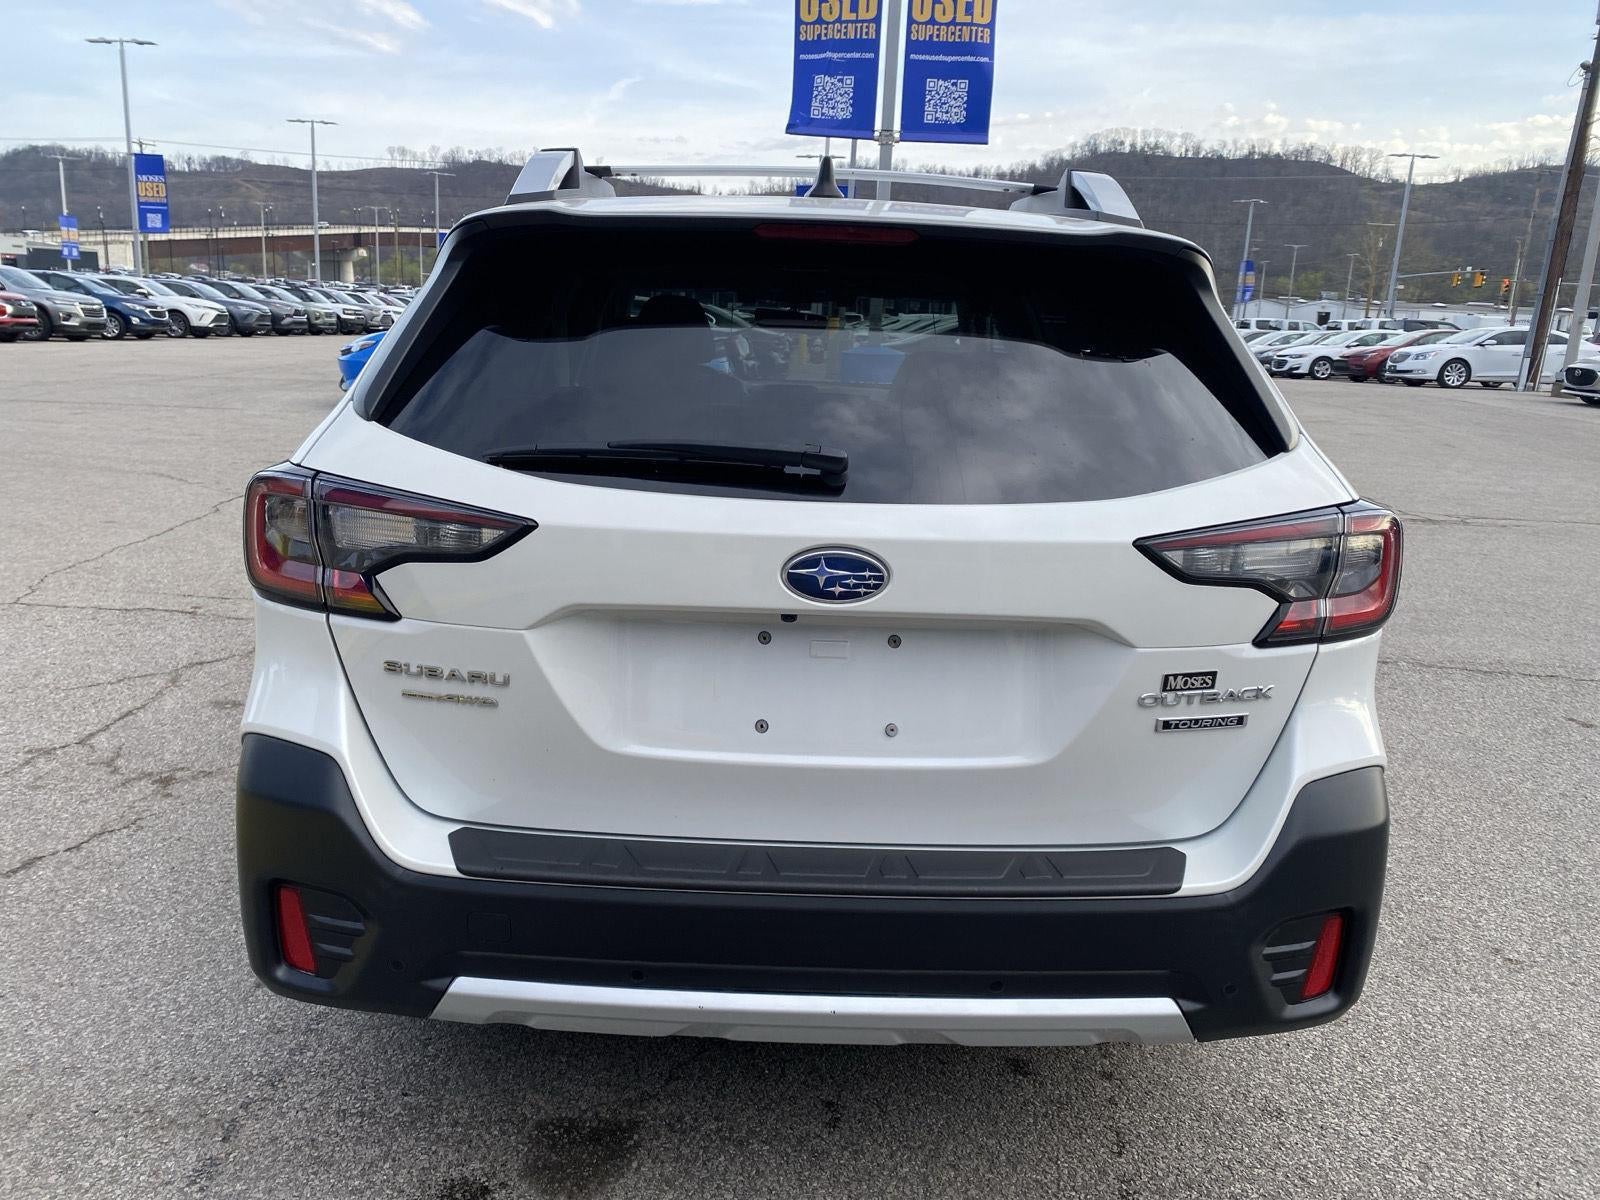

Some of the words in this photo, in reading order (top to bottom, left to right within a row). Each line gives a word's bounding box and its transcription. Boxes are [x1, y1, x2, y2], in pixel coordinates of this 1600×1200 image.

[800, 23, 876, 41] SUPERCENTER
[911, 24, 990, 44] SUPERCENTER
[910, 53, 990, 63] mosesusedsupercenter.com
[137, 174, 165, 182] MOSES
[137, 181, 167, 197] USED
[383, 660, 511, 687] SUBARU
[1137, 685, 1275, 707] OUTBACK
[1168, 717, 1240, 730] TOURING
